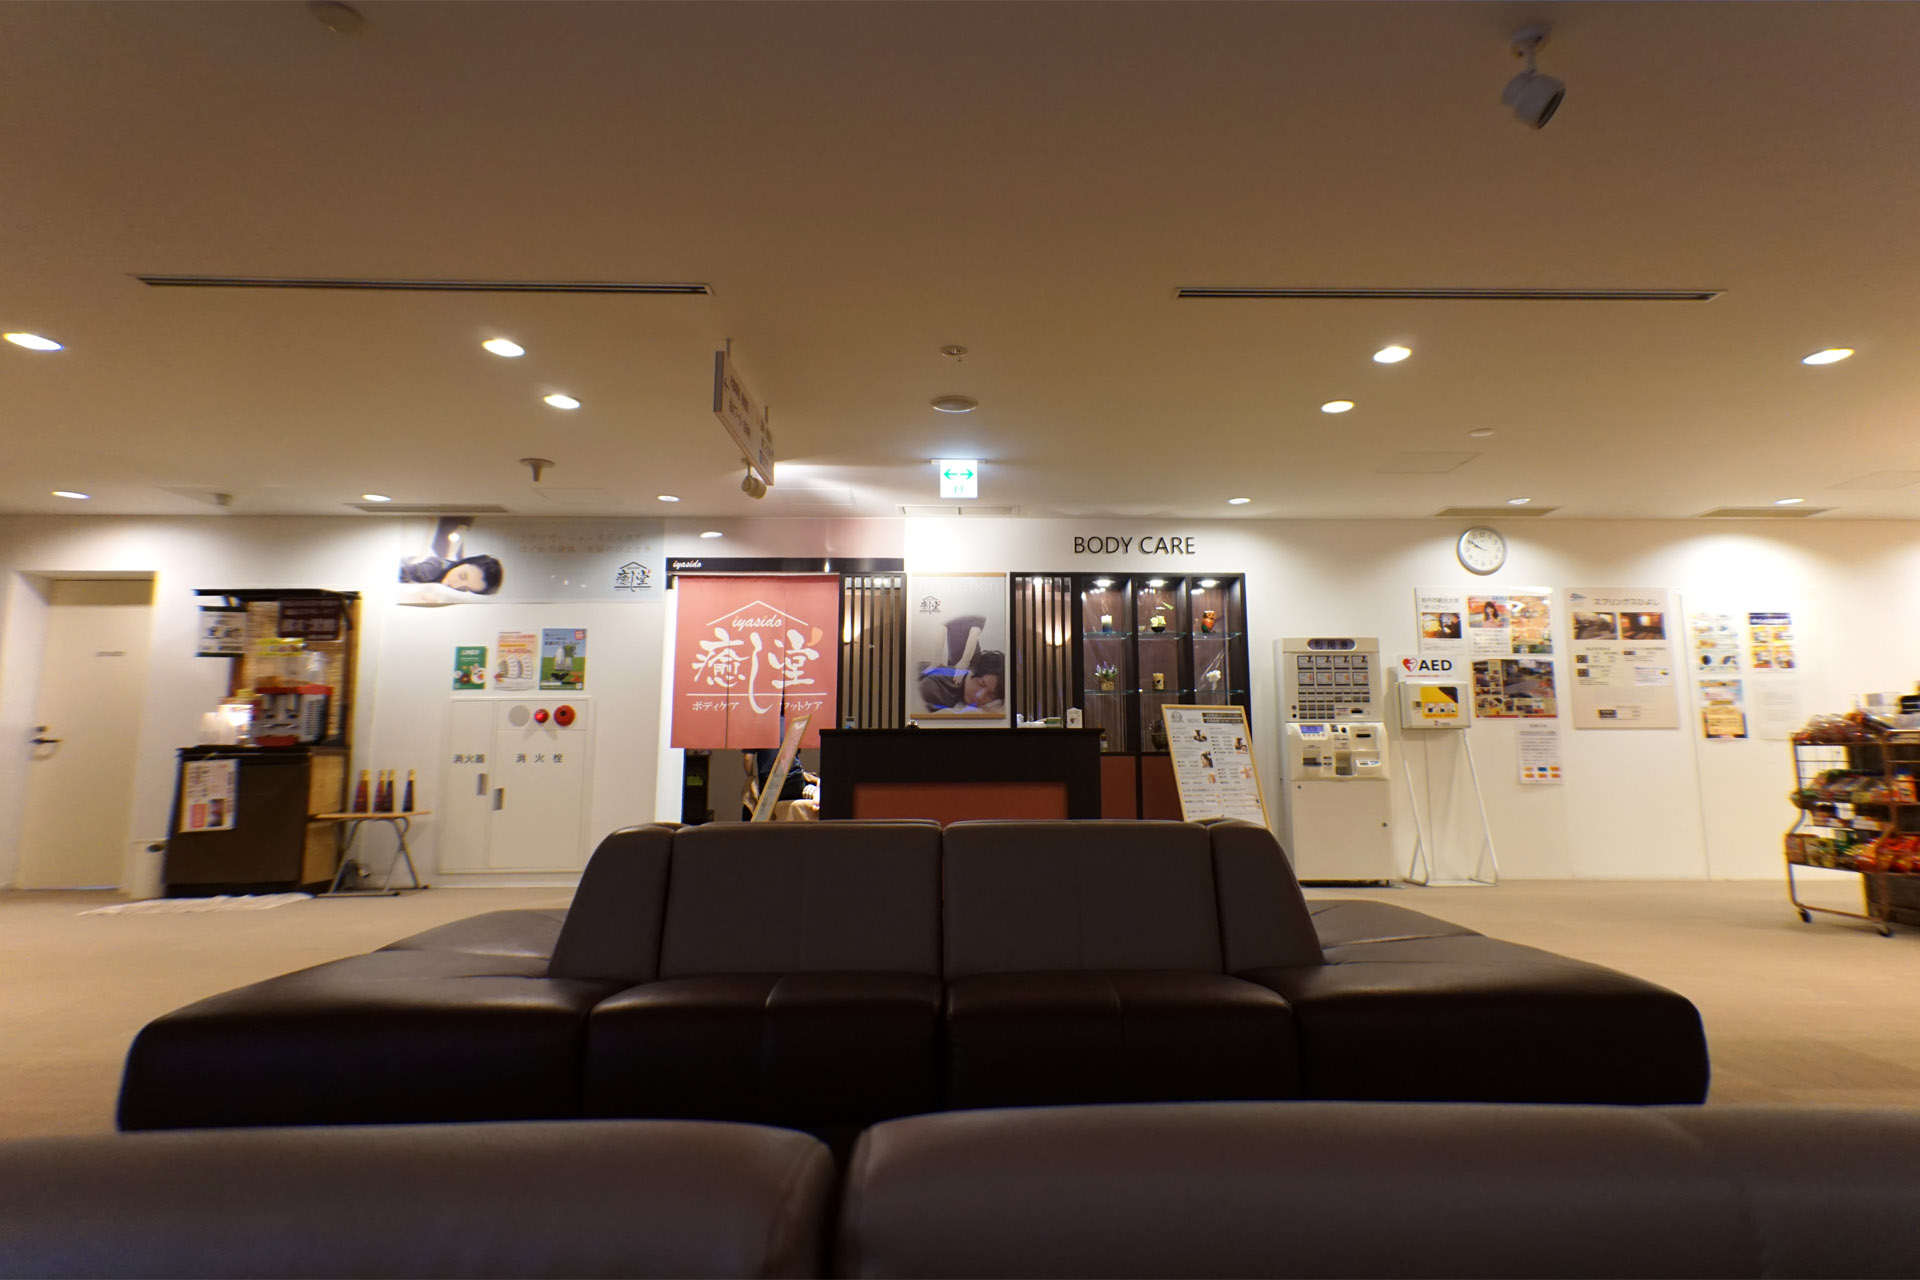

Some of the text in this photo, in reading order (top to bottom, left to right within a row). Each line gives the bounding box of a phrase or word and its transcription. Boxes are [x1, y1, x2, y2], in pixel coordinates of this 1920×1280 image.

[1074, 536, 1196, 554] BODY CARE
[672, 559, 702, 569] iyasido
[732, 614, 782, 631] iyasido
[692, 627, 823, 714] 癒し堂
[1418, 659, 1453, 672] AED
[692, 701, 740, 712] ボディケア
[452, 753, 486, 764] 消火器
[515, 753, 564, 764] 消火栓
